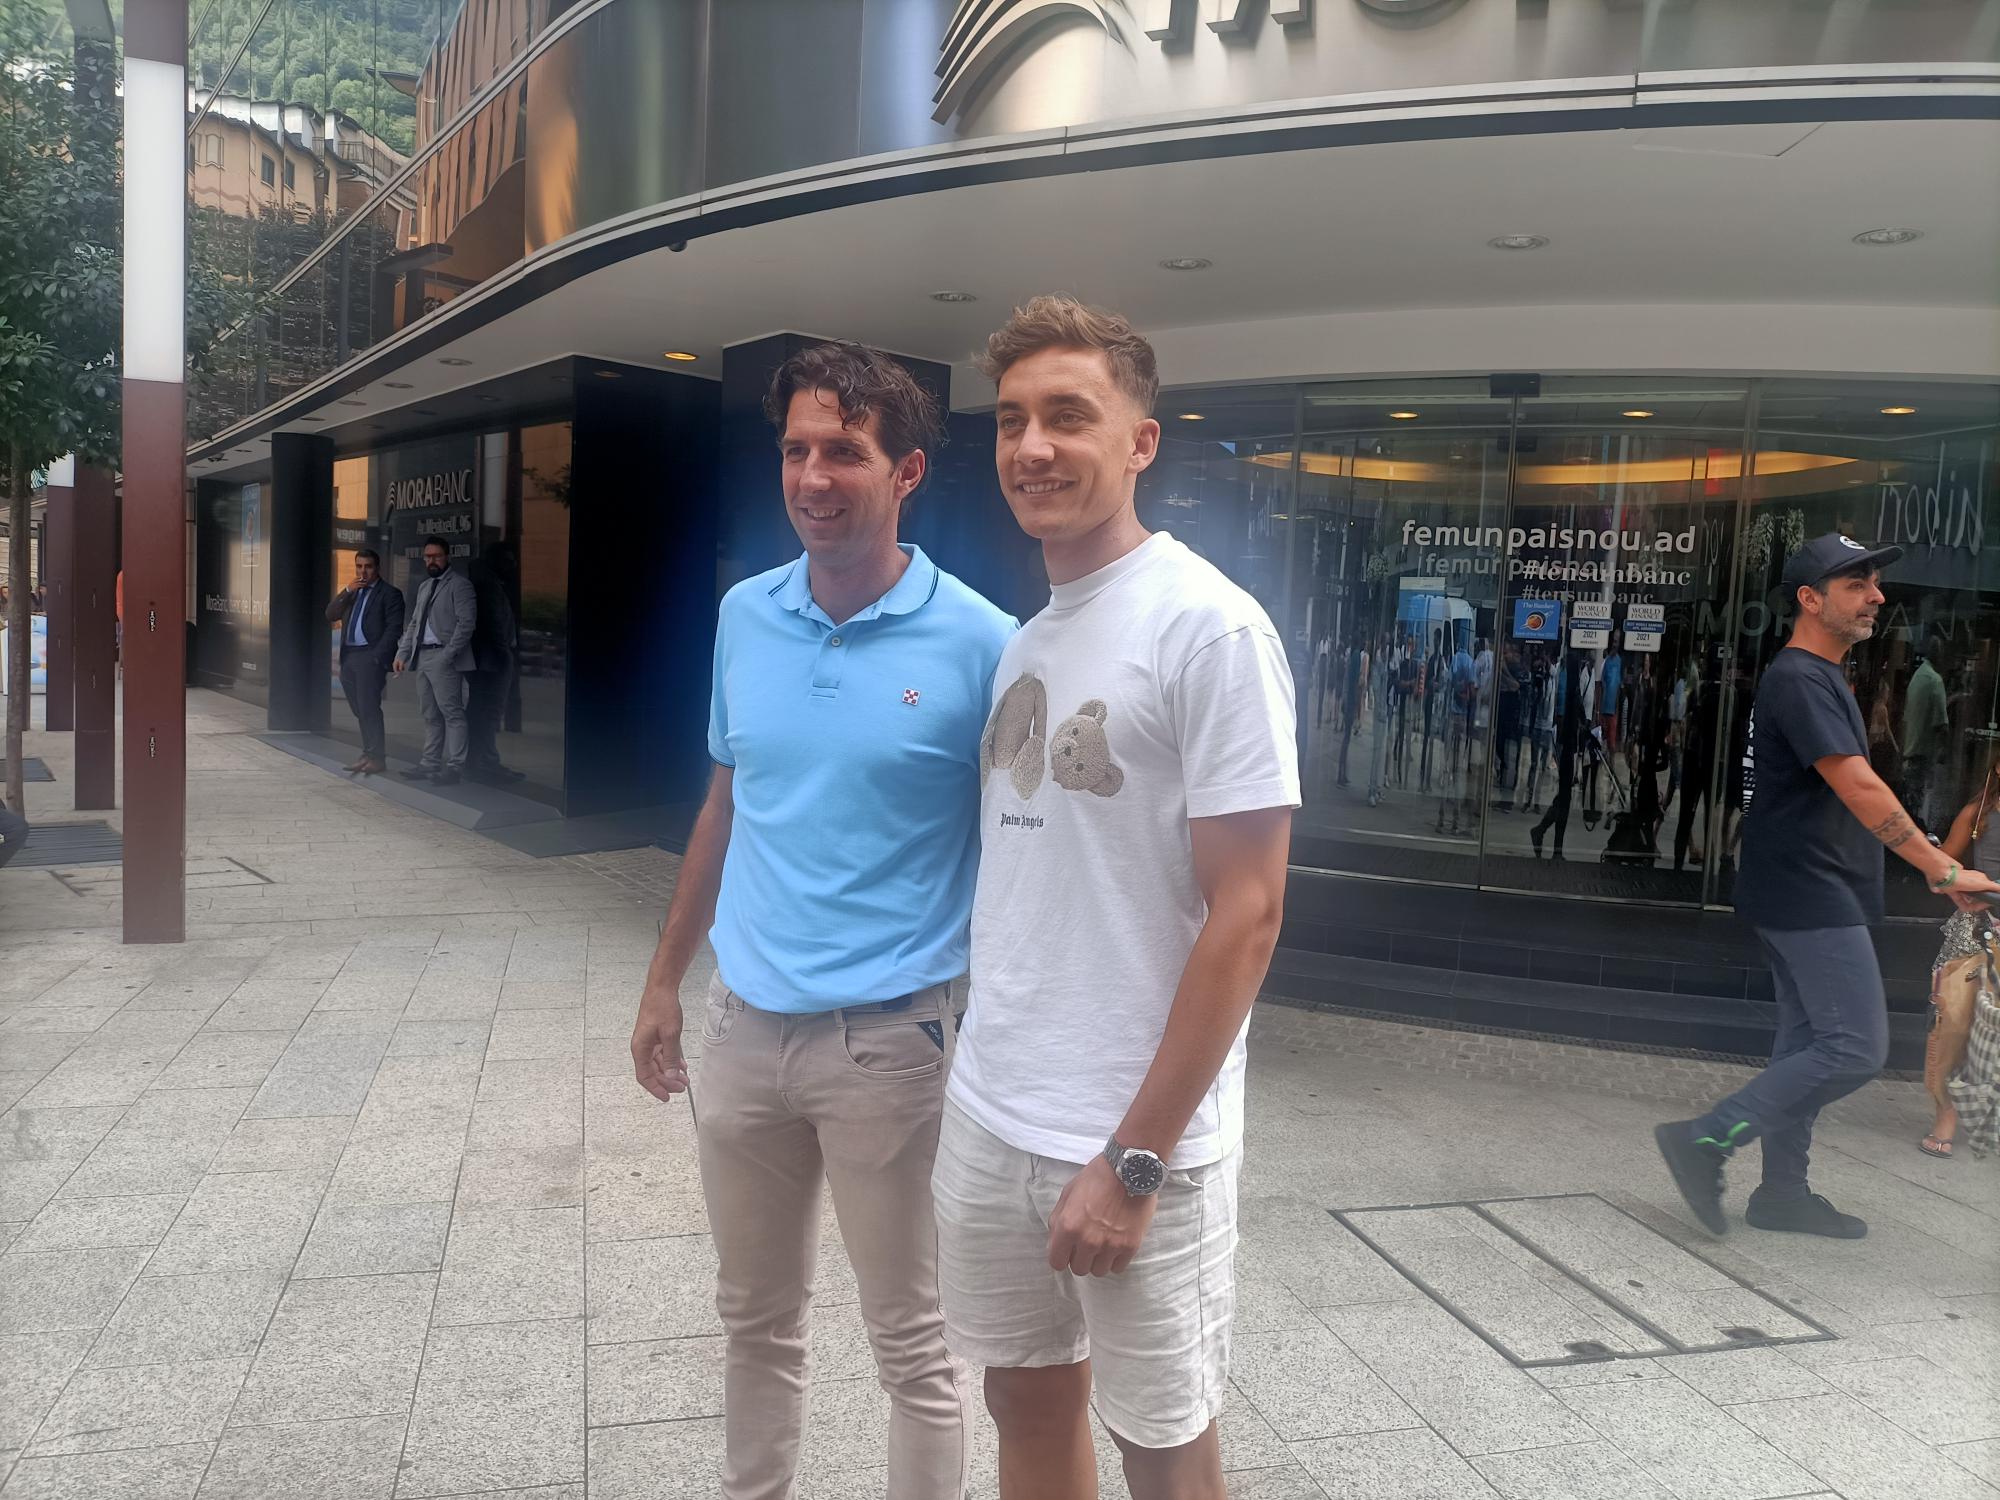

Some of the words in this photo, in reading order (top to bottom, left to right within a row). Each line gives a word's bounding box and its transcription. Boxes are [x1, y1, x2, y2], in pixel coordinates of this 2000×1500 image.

[396, 469, 472, 510] MORABANC
[1522, 560, 1691, 586] #tensunbanc
[1583, 630, 1597, 638] 2021
[1636, 633, 1650, 641] 2021
